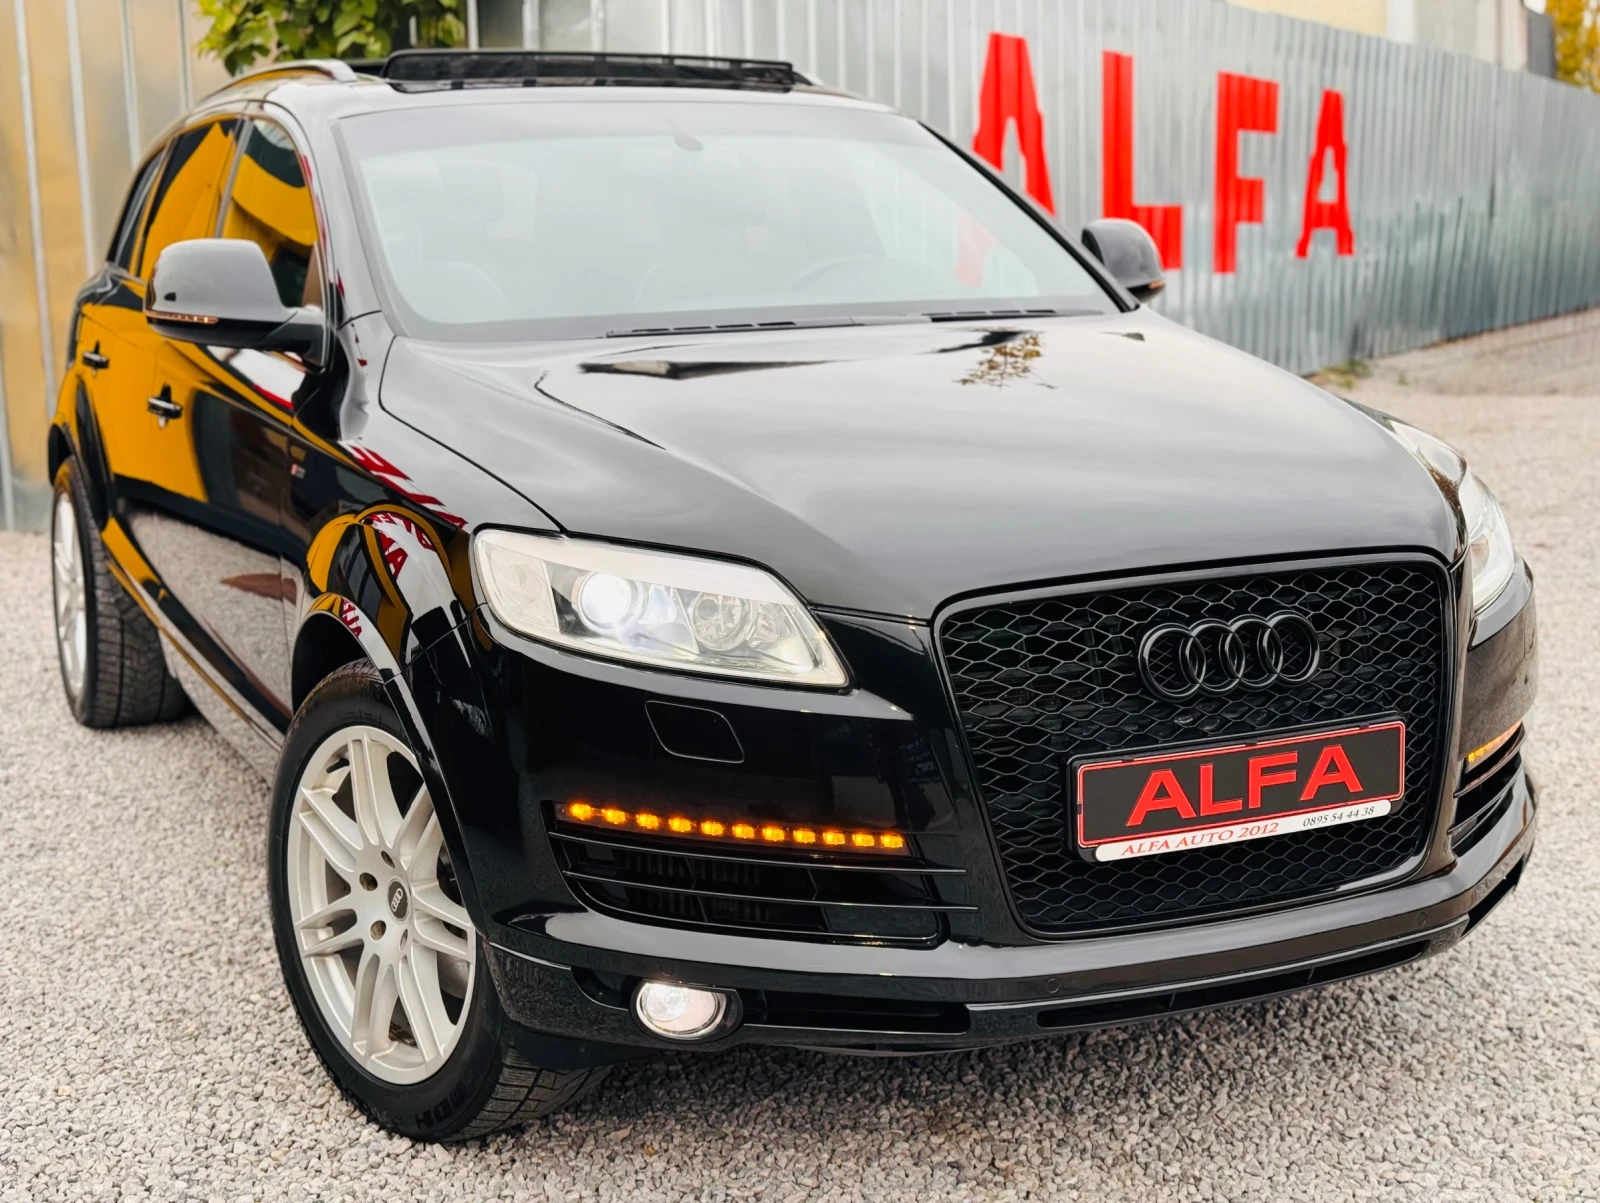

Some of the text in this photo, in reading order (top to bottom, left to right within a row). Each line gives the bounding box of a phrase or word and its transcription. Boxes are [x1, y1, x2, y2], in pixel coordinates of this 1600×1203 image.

[955, 32, 1354, 285] ALFA
[1126, 745, 1363, 826] ALFA
[1121, 822, 1279, 856] ALFA AUTO 2012
[1303, 806, 1375, 828] 0895 54 44 38
